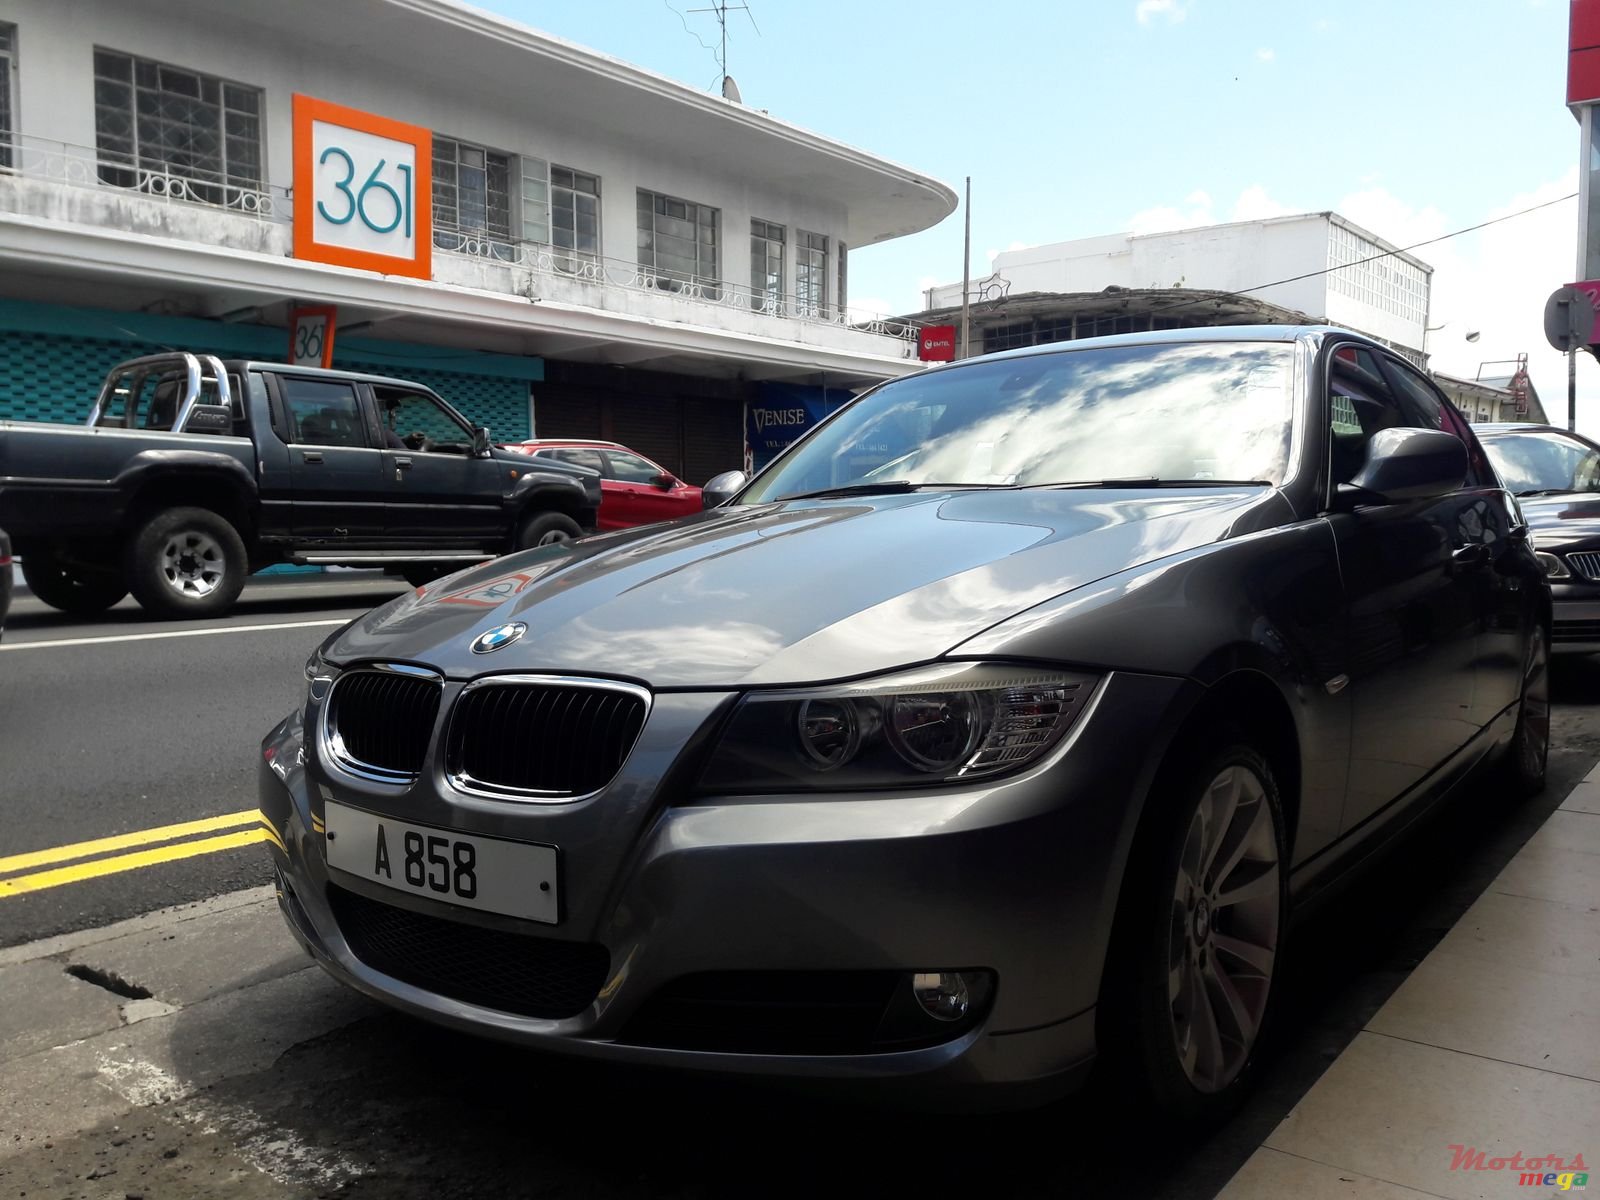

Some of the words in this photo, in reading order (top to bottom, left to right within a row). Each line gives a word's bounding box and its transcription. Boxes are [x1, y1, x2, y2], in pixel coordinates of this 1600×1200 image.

[317, 147, 412, 239] 361
[295, 324, 325, 359] 361
[933, 340, 950, 348] EMTEL
[752, 408, 805, 434] VENISE
[375, 824, 392, 880] A
[404, 831, 477, 900] 858
